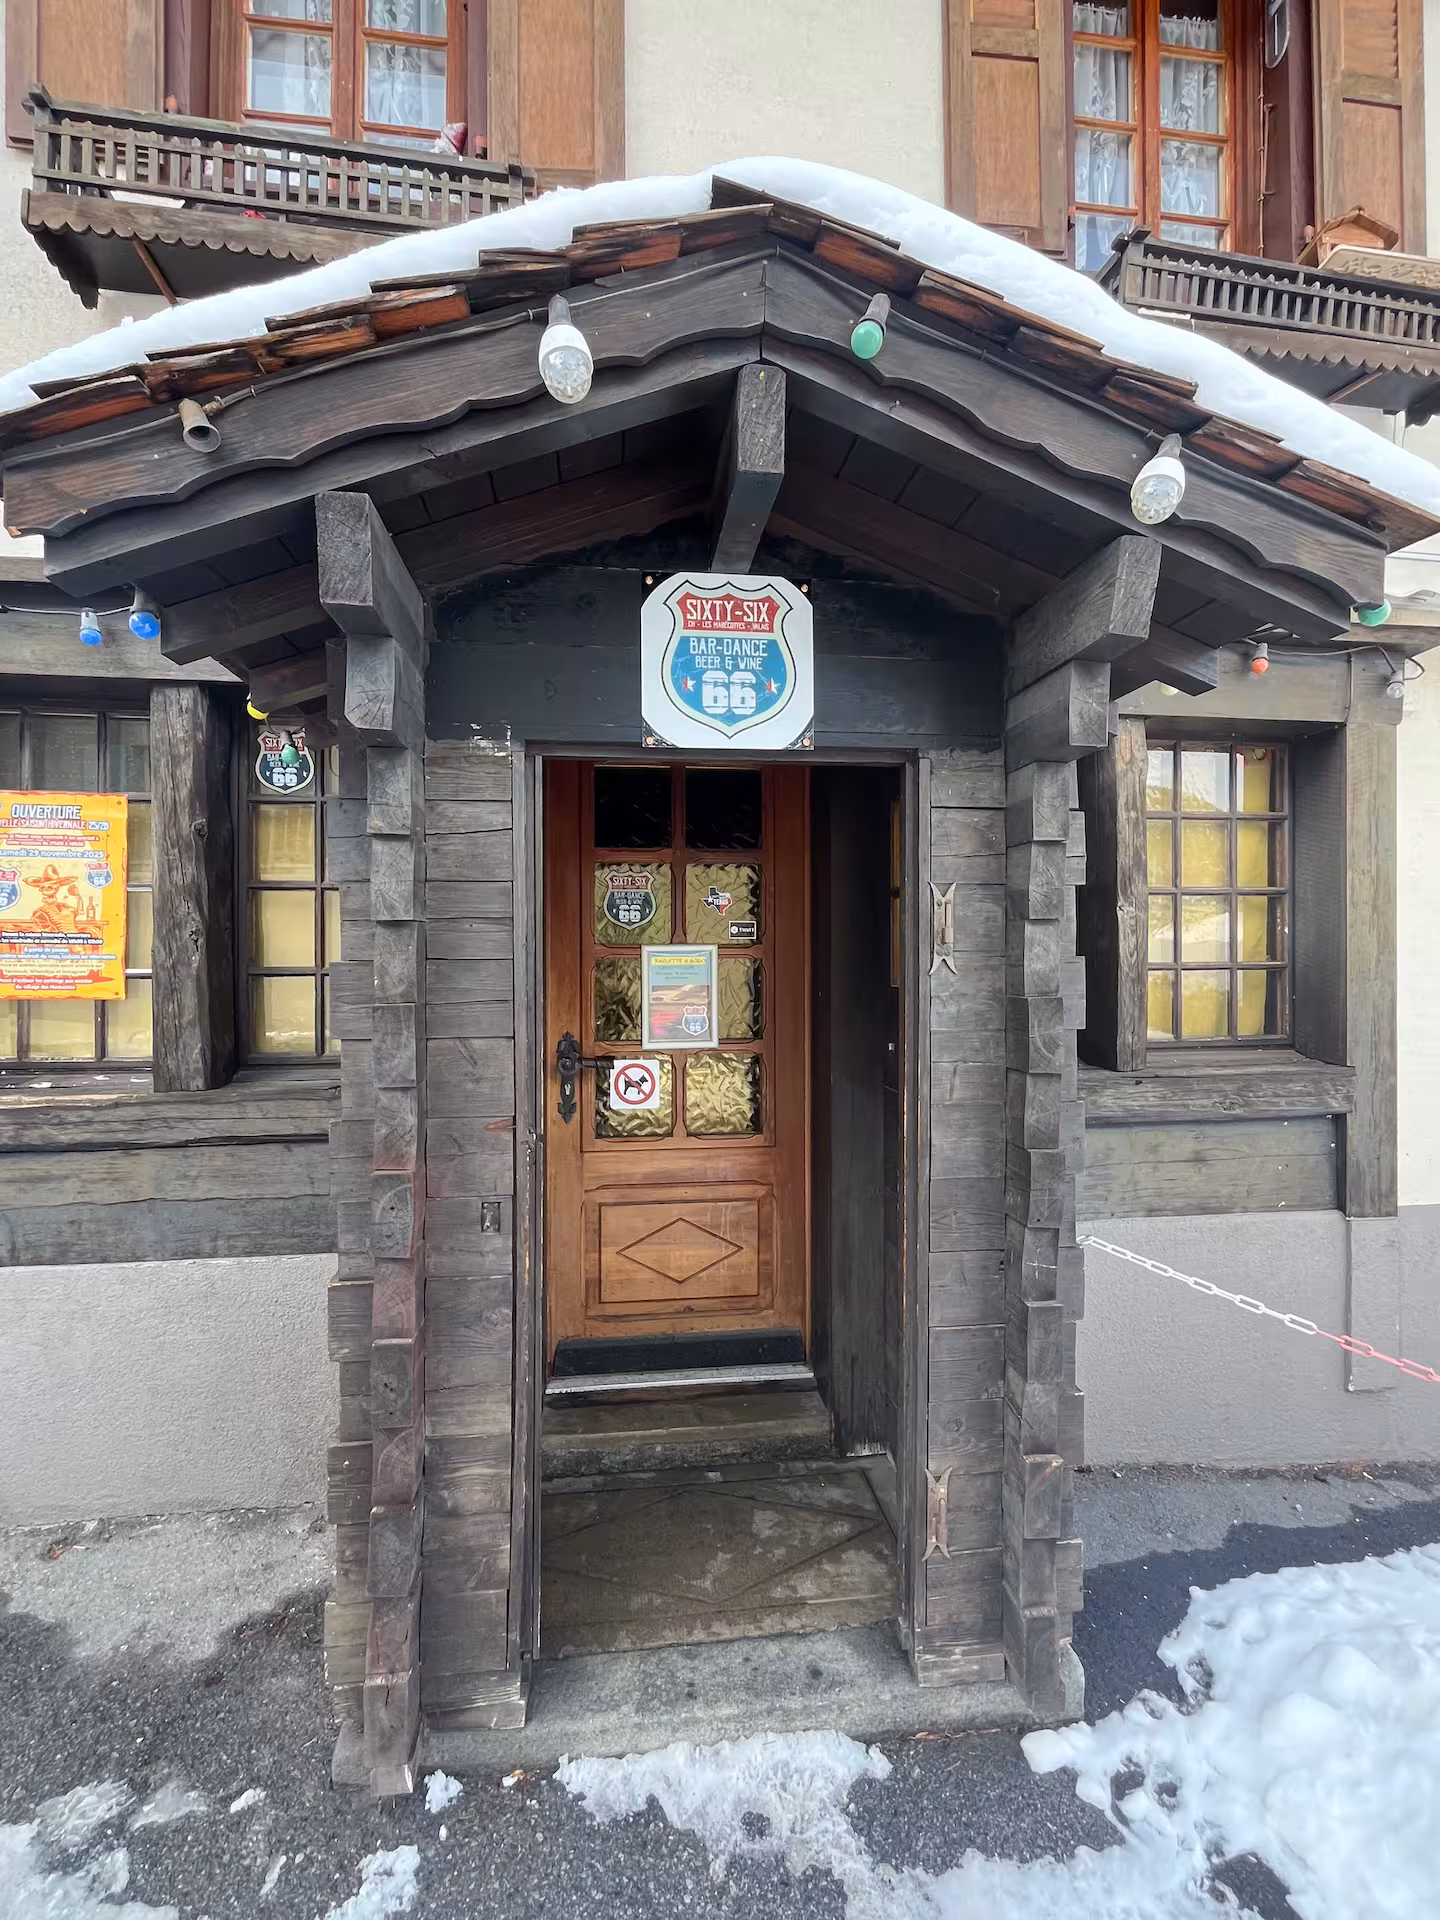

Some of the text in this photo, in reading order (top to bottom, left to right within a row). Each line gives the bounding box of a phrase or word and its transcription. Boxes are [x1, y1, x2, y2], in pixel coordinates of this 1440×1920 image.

[752, 623, 769, 631] VALAIS
[695, 656, 763, 670] BEER & WINE
[702, 670, 756, 714] 66
[272, 767, 298, 787] 66
[11, 804, 82, 819] OUVERTURE
[20, 819, 45, 828] SAISON
[47, 820, 87, 830] HIVERNALE
[28, 849, 39, 857] 29
[41, 850, 82, 858] novembre
[83, 851, 104, 859] 2025
[612, 876, 647, 886] SIXTY-SIX
[619, 904, 641, 922] 66
[690, 1022, 702, 1032] 66
